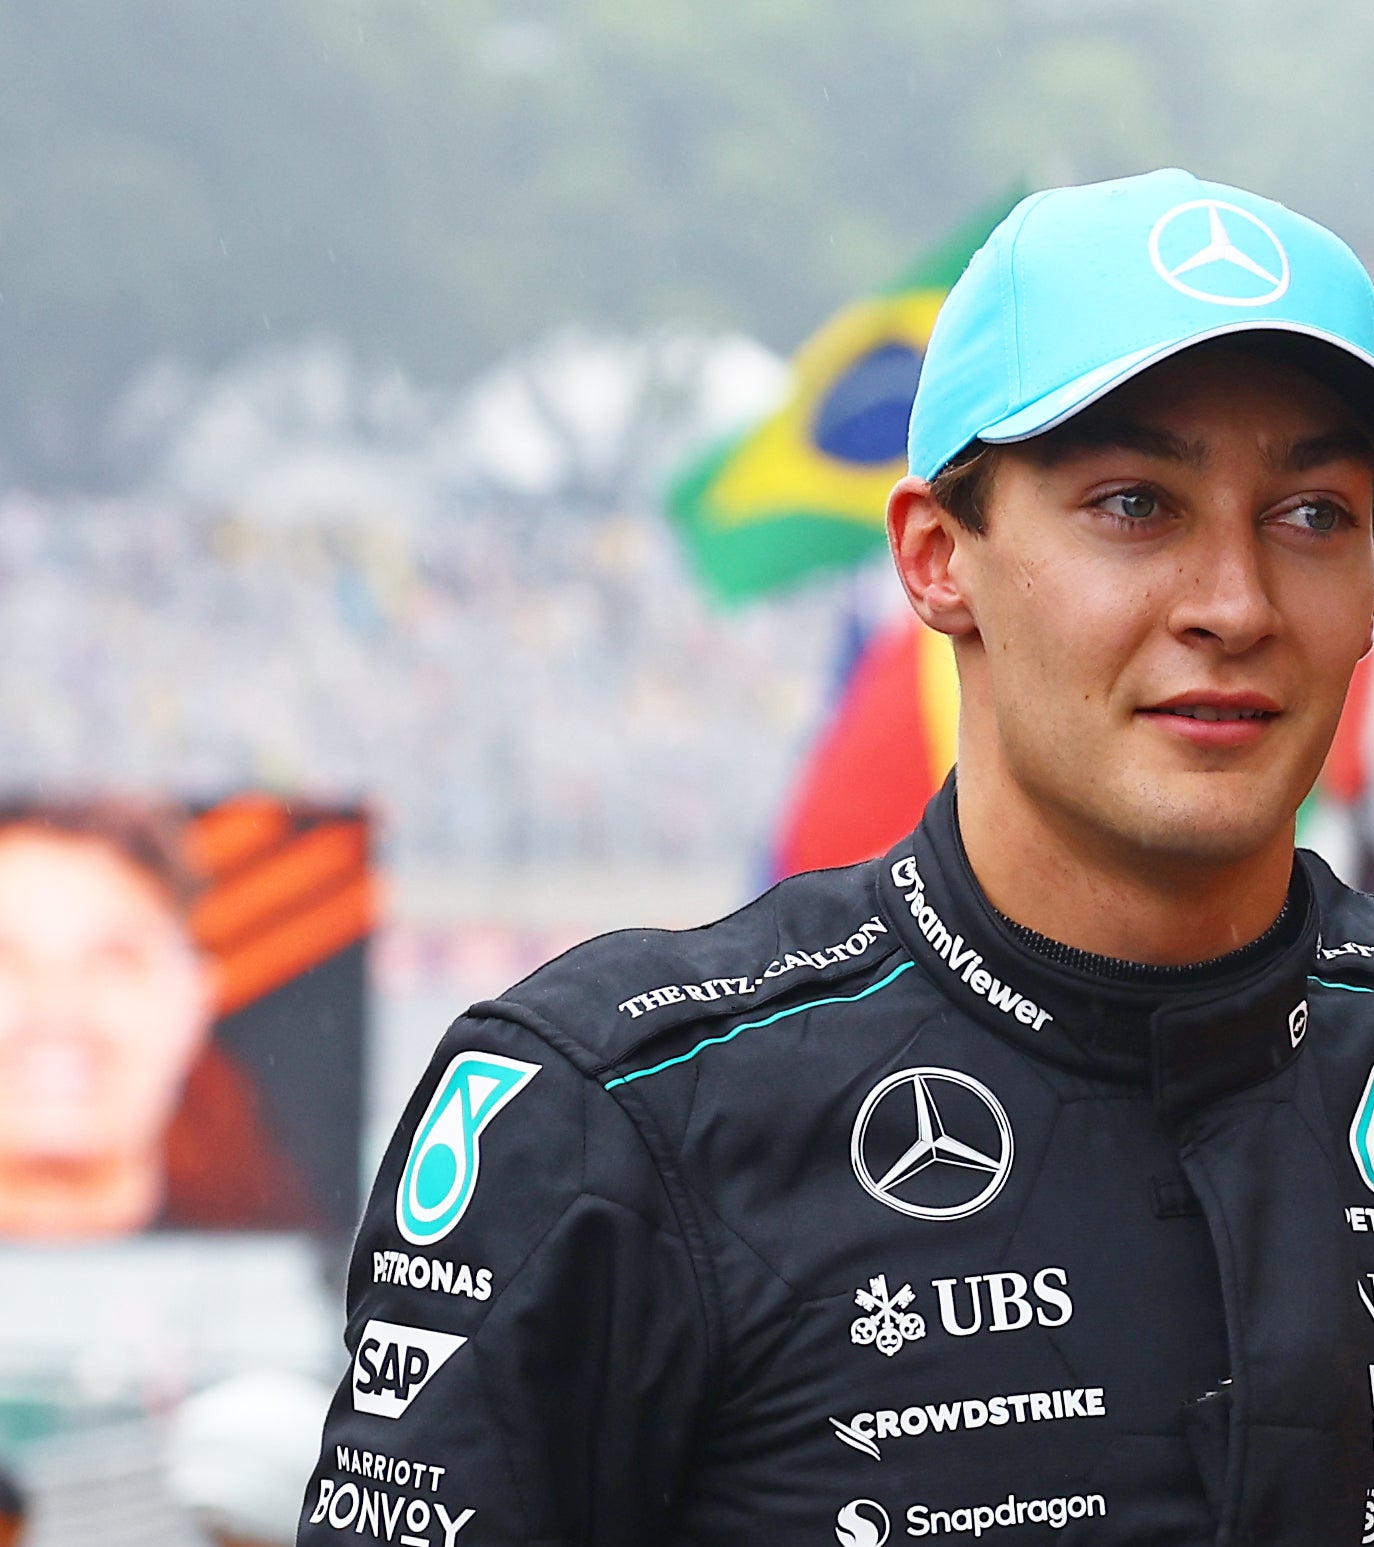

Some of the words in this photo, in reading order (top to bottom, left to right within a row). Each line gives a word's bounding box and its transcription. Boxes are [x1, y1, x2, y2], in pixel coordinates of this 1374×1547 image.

[902, 877, 1054, 1032] TeamViewer
[618, 984, 688, 1019] THE
[373, 1250, 494, 1302] PETRONAS
[931, 1267, 1075, 1337] UBS
[355, 1338, 430, 1401] SAP
[850, 1387, 1107, 1440] CROWDSTRIKE
[336, 1444, 446, 1492] MARRIOTT
[905, 1493, 1107, 1538] Snapdragon
